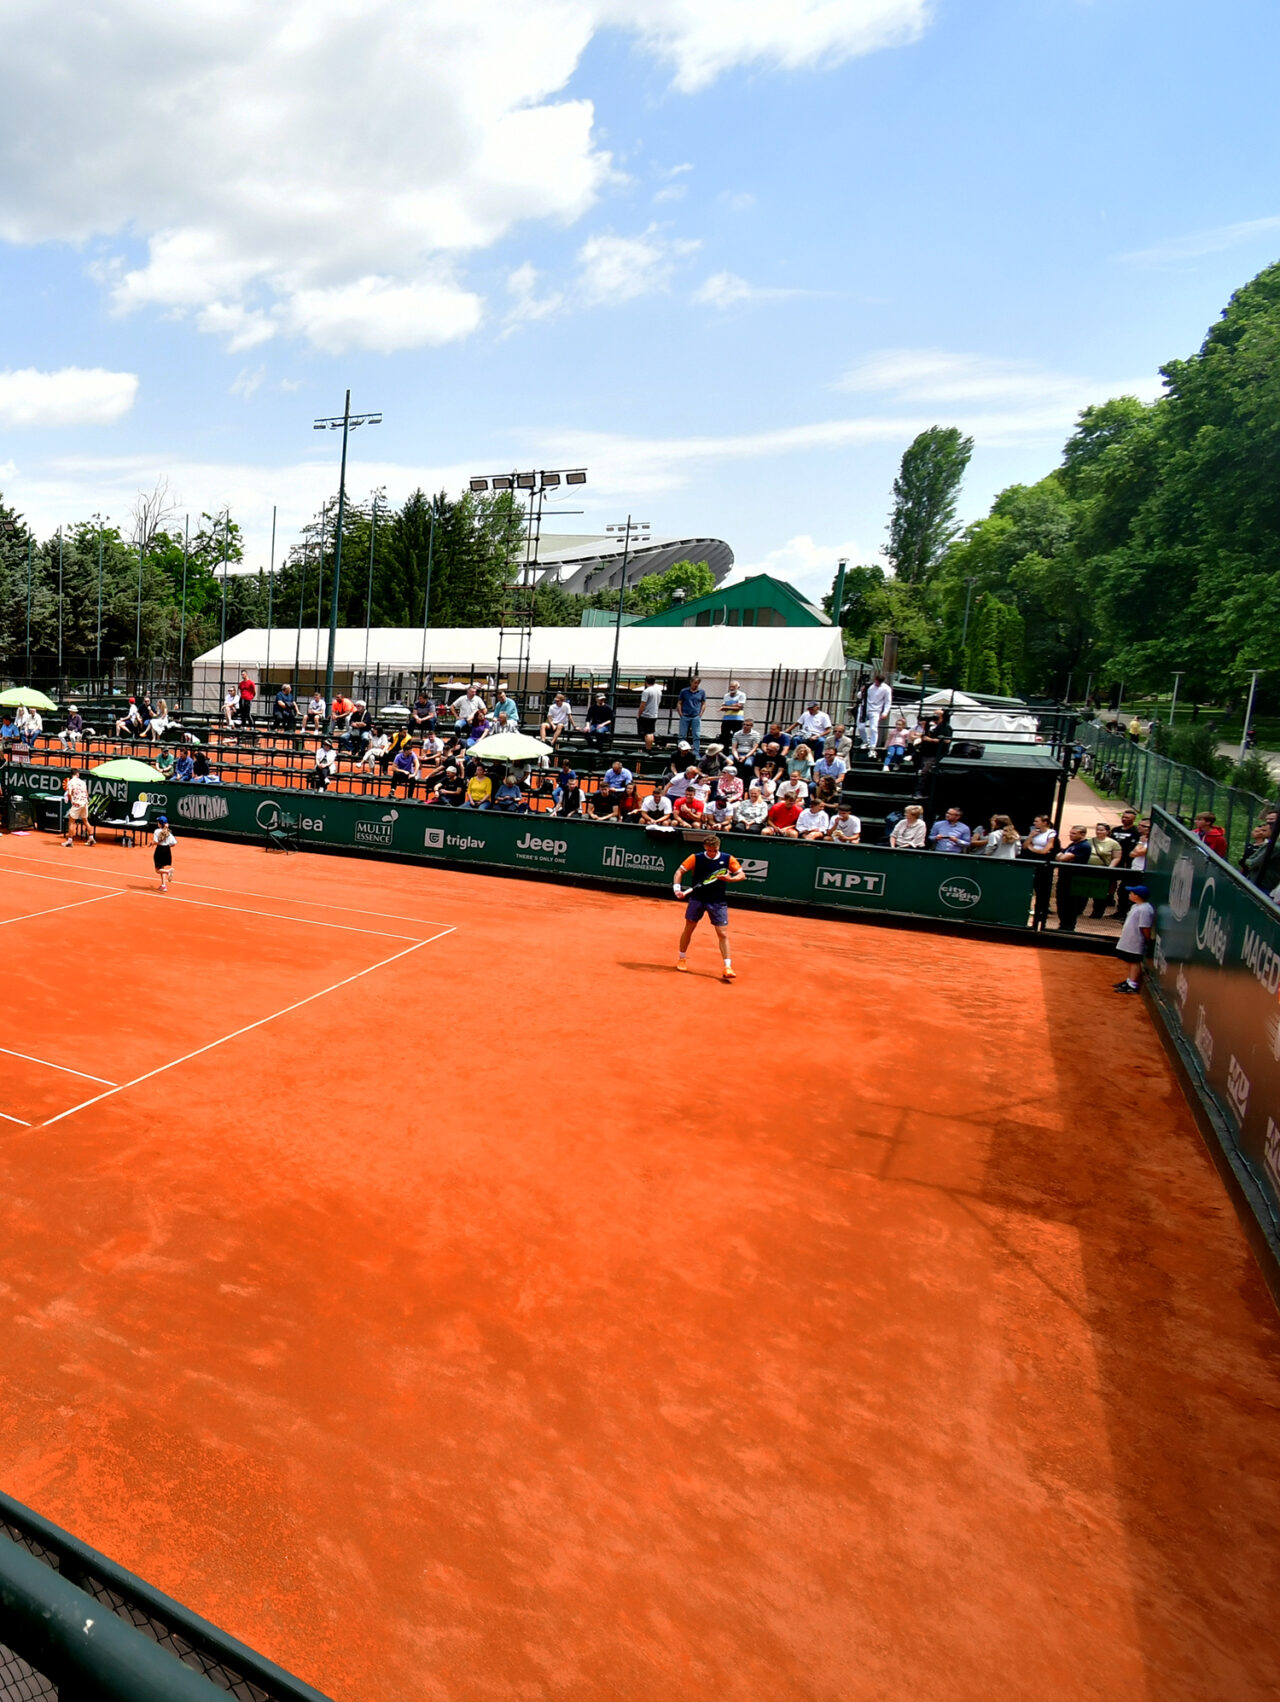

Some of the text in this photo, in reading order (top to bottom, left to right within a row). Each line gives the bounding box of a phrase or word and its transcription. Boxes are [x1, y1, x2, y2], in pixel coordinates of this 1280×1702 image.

[177, 794, 229, 822] CEVITANA
[357, 822, 391, 836] MULTI
[356, 833, 390, 844] ESSENCE
[446, 834, 485, 850] triglav
[516, 833, 567, 855] Jeep
[516, 853, 538, 861] THERE'S
[539, 855, 553, 863] ONLY
[624, 852, 665, 867] PORTA
[624, 863, 665, 872] ENGINEERING
[941, 886, 965, 894] city
[1241, 924, 1280, 995] MACED
